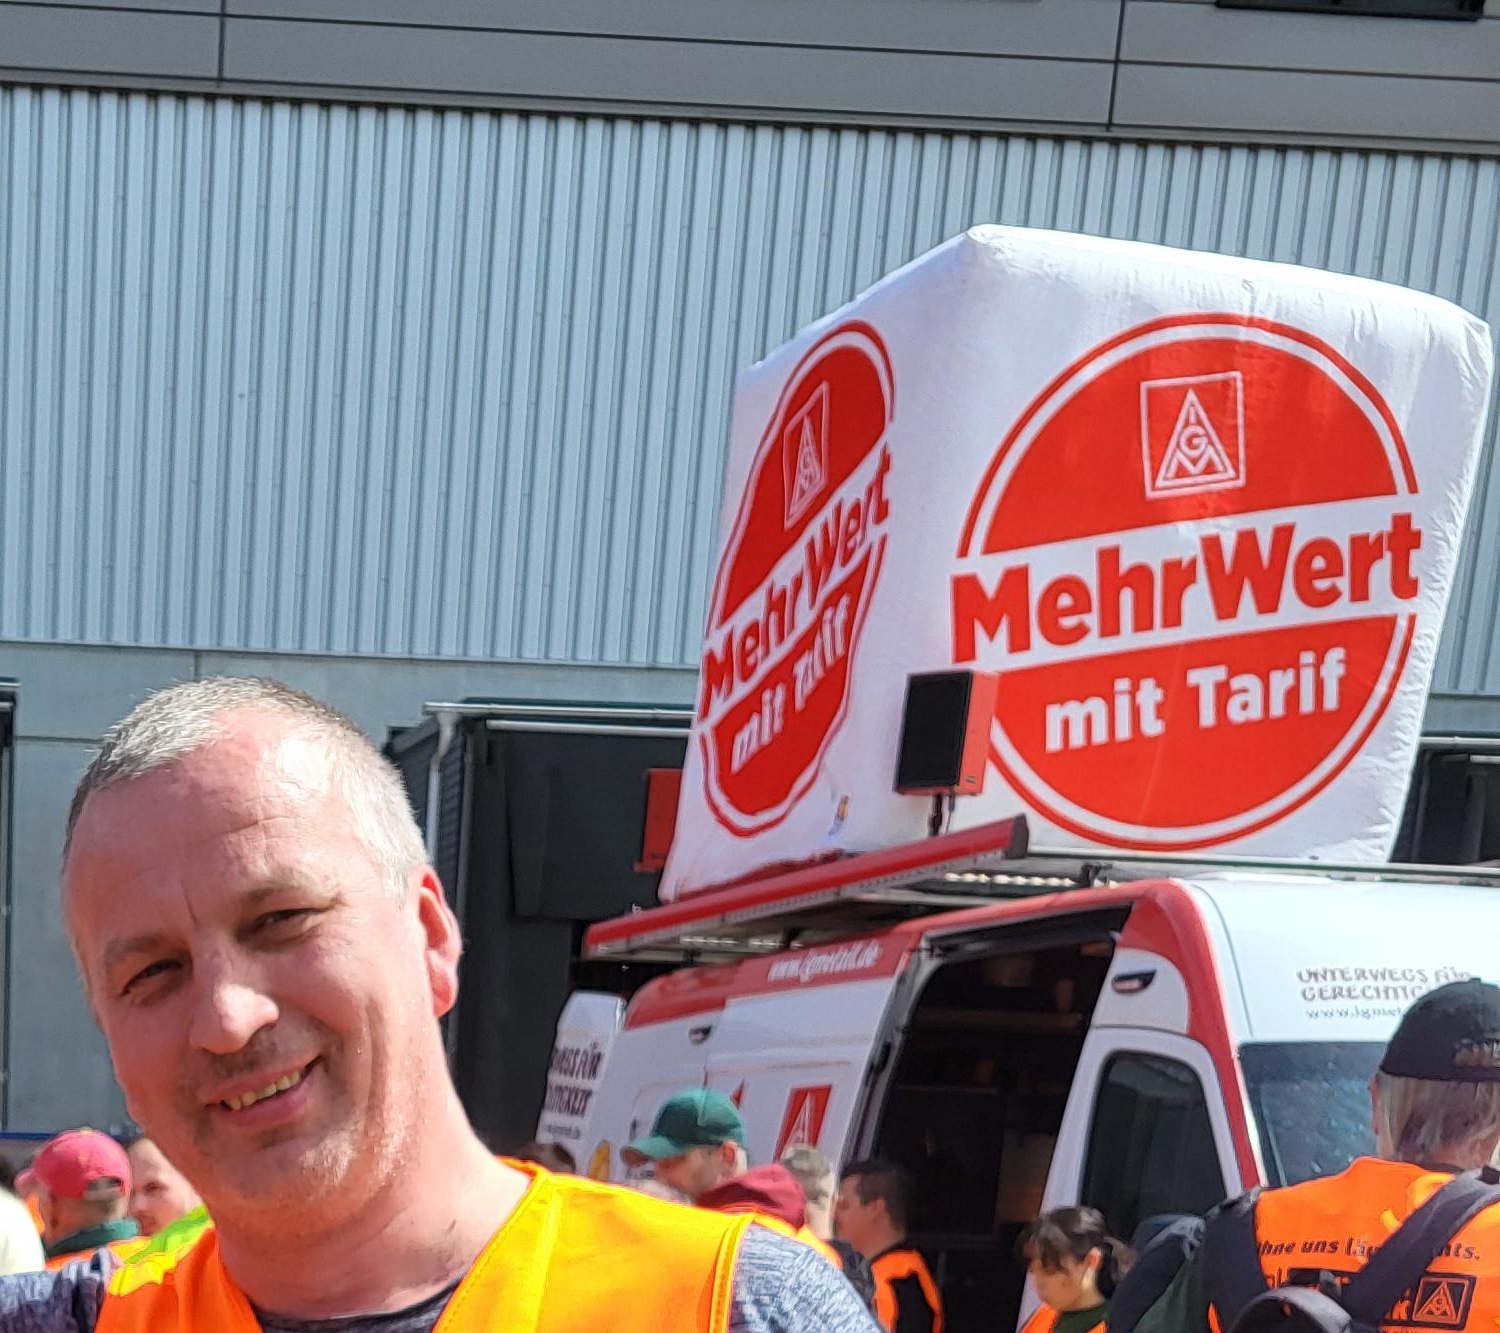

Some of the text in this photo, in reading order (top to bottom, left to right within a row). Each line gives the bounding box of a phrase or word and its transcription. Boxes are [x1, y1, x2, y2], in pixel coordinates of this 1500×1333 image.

[700, 442, 891, 724] MehrWert
[952, 512, 1422, 664] MehrWert
[731, 684, 786, 774] mit
[1046, 647, 1347, 753] mit Tarif
[1298, 966, 1428, 983] UNTERWEGS
[1300, 1239, 1339, 1254] uns
